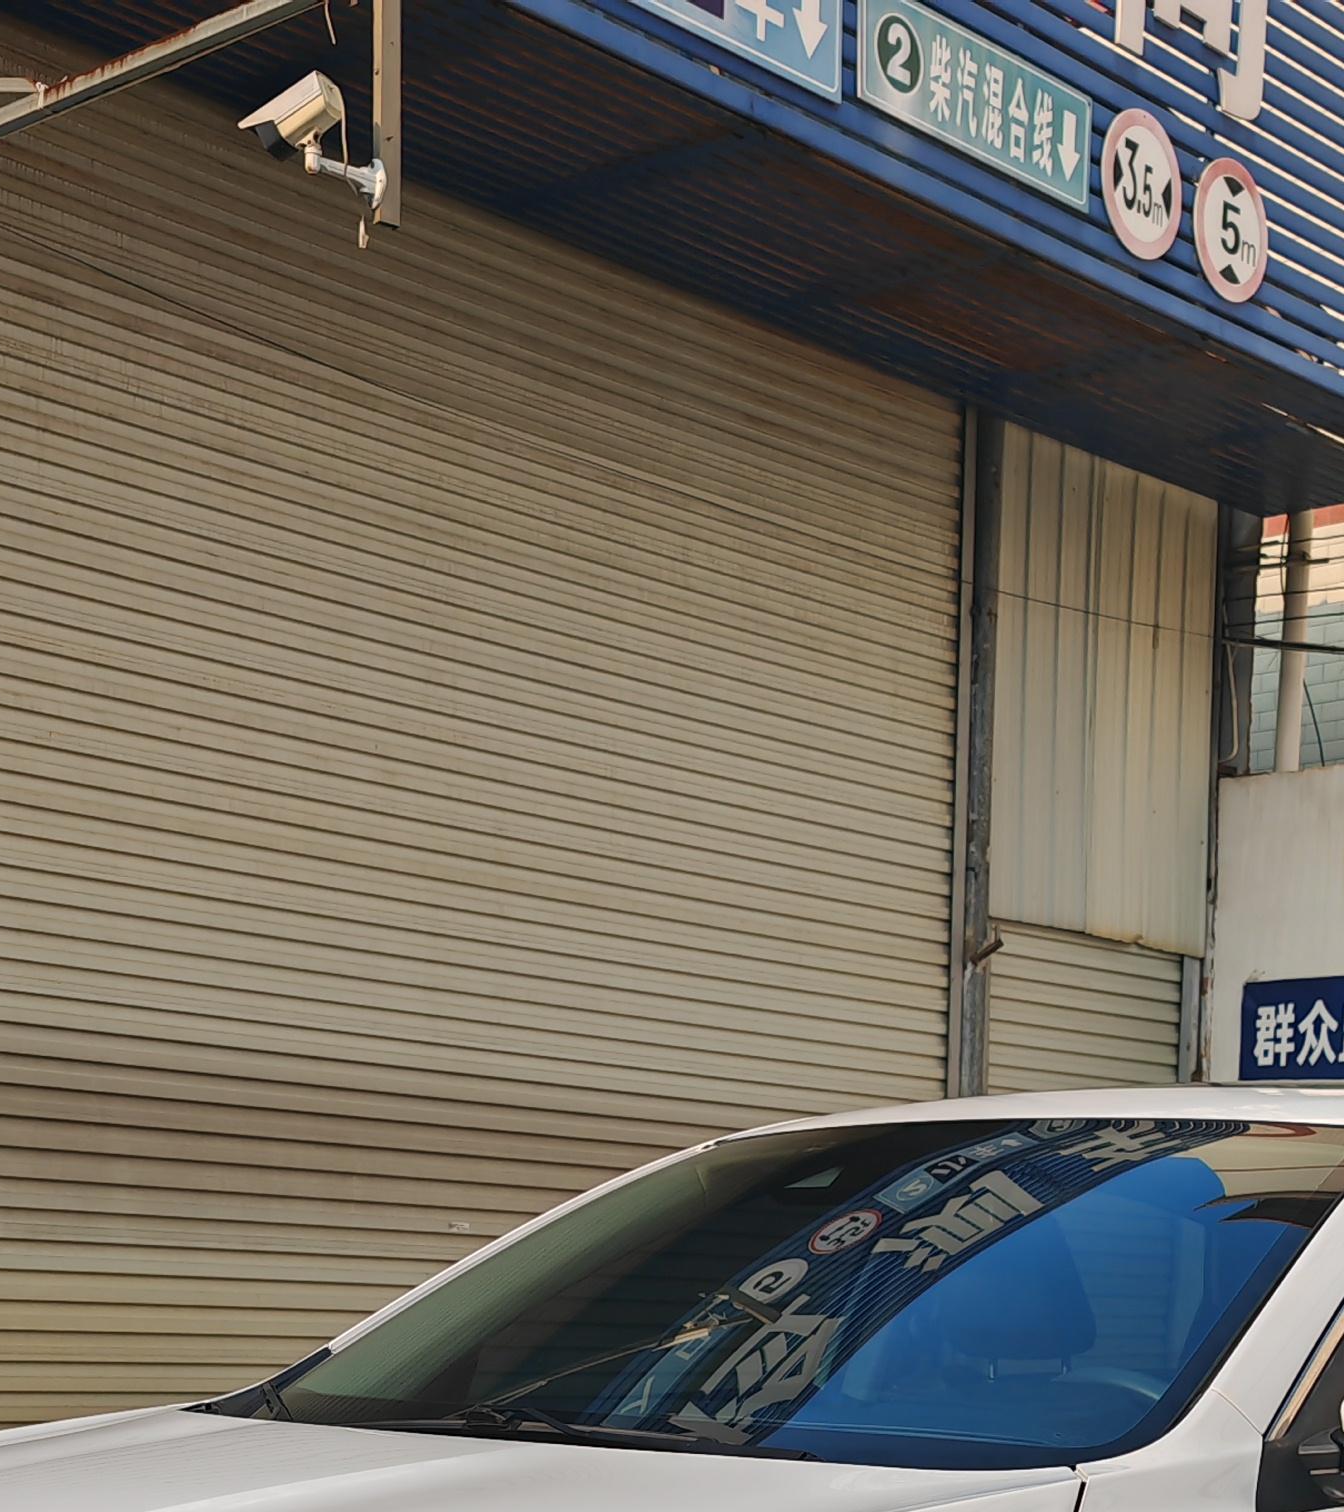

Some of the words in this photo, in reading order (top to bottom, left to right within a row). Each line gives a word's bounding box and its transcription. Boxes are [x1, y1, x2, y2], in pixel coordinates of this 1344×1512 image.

[928, 34, 1055, 178] 柴汽混合线
[1124, 137, 1164, 228] 3.5m
[1221, 200, 1257, 268] 5m
